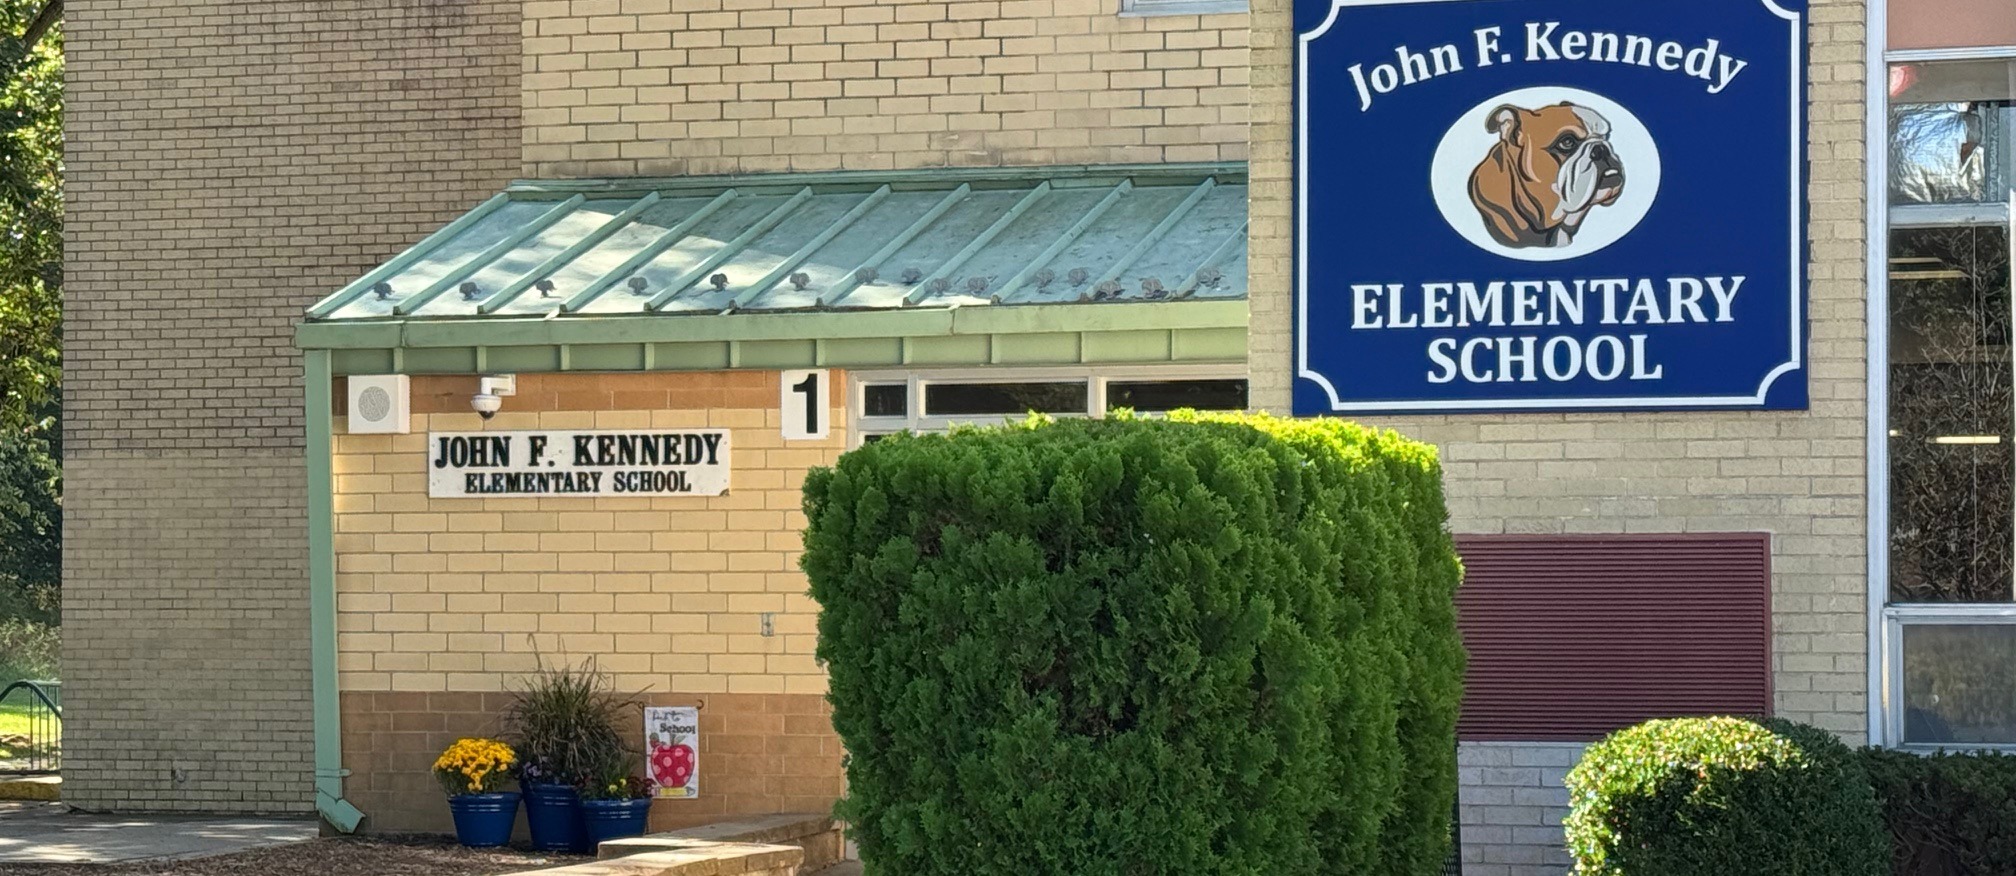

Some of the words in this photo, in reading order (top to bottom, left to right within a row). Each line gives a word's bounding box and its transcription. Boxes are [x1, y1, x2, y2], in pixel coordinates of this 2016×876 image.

[1348, 33, 1464, 111] John
[1475, 26, 1513, 68] F.
[1525, 21, 1748, 93] Kennedy
[1350, 276, 1746, 328] ELEMENTARY
[1428, 335, 1662, 383] SCHOOL
[792, 373, 818, 434] 1
[435, 436, 511, 468] JOHN
[528, 435, 555, 467] F.
[572, 434, 722, 467] KENNEDY
[464, 471, 603, 493] ELEMENTARY
[613, 470, 691, 493] SCHOOL
[659, 723, 696, 734] School
